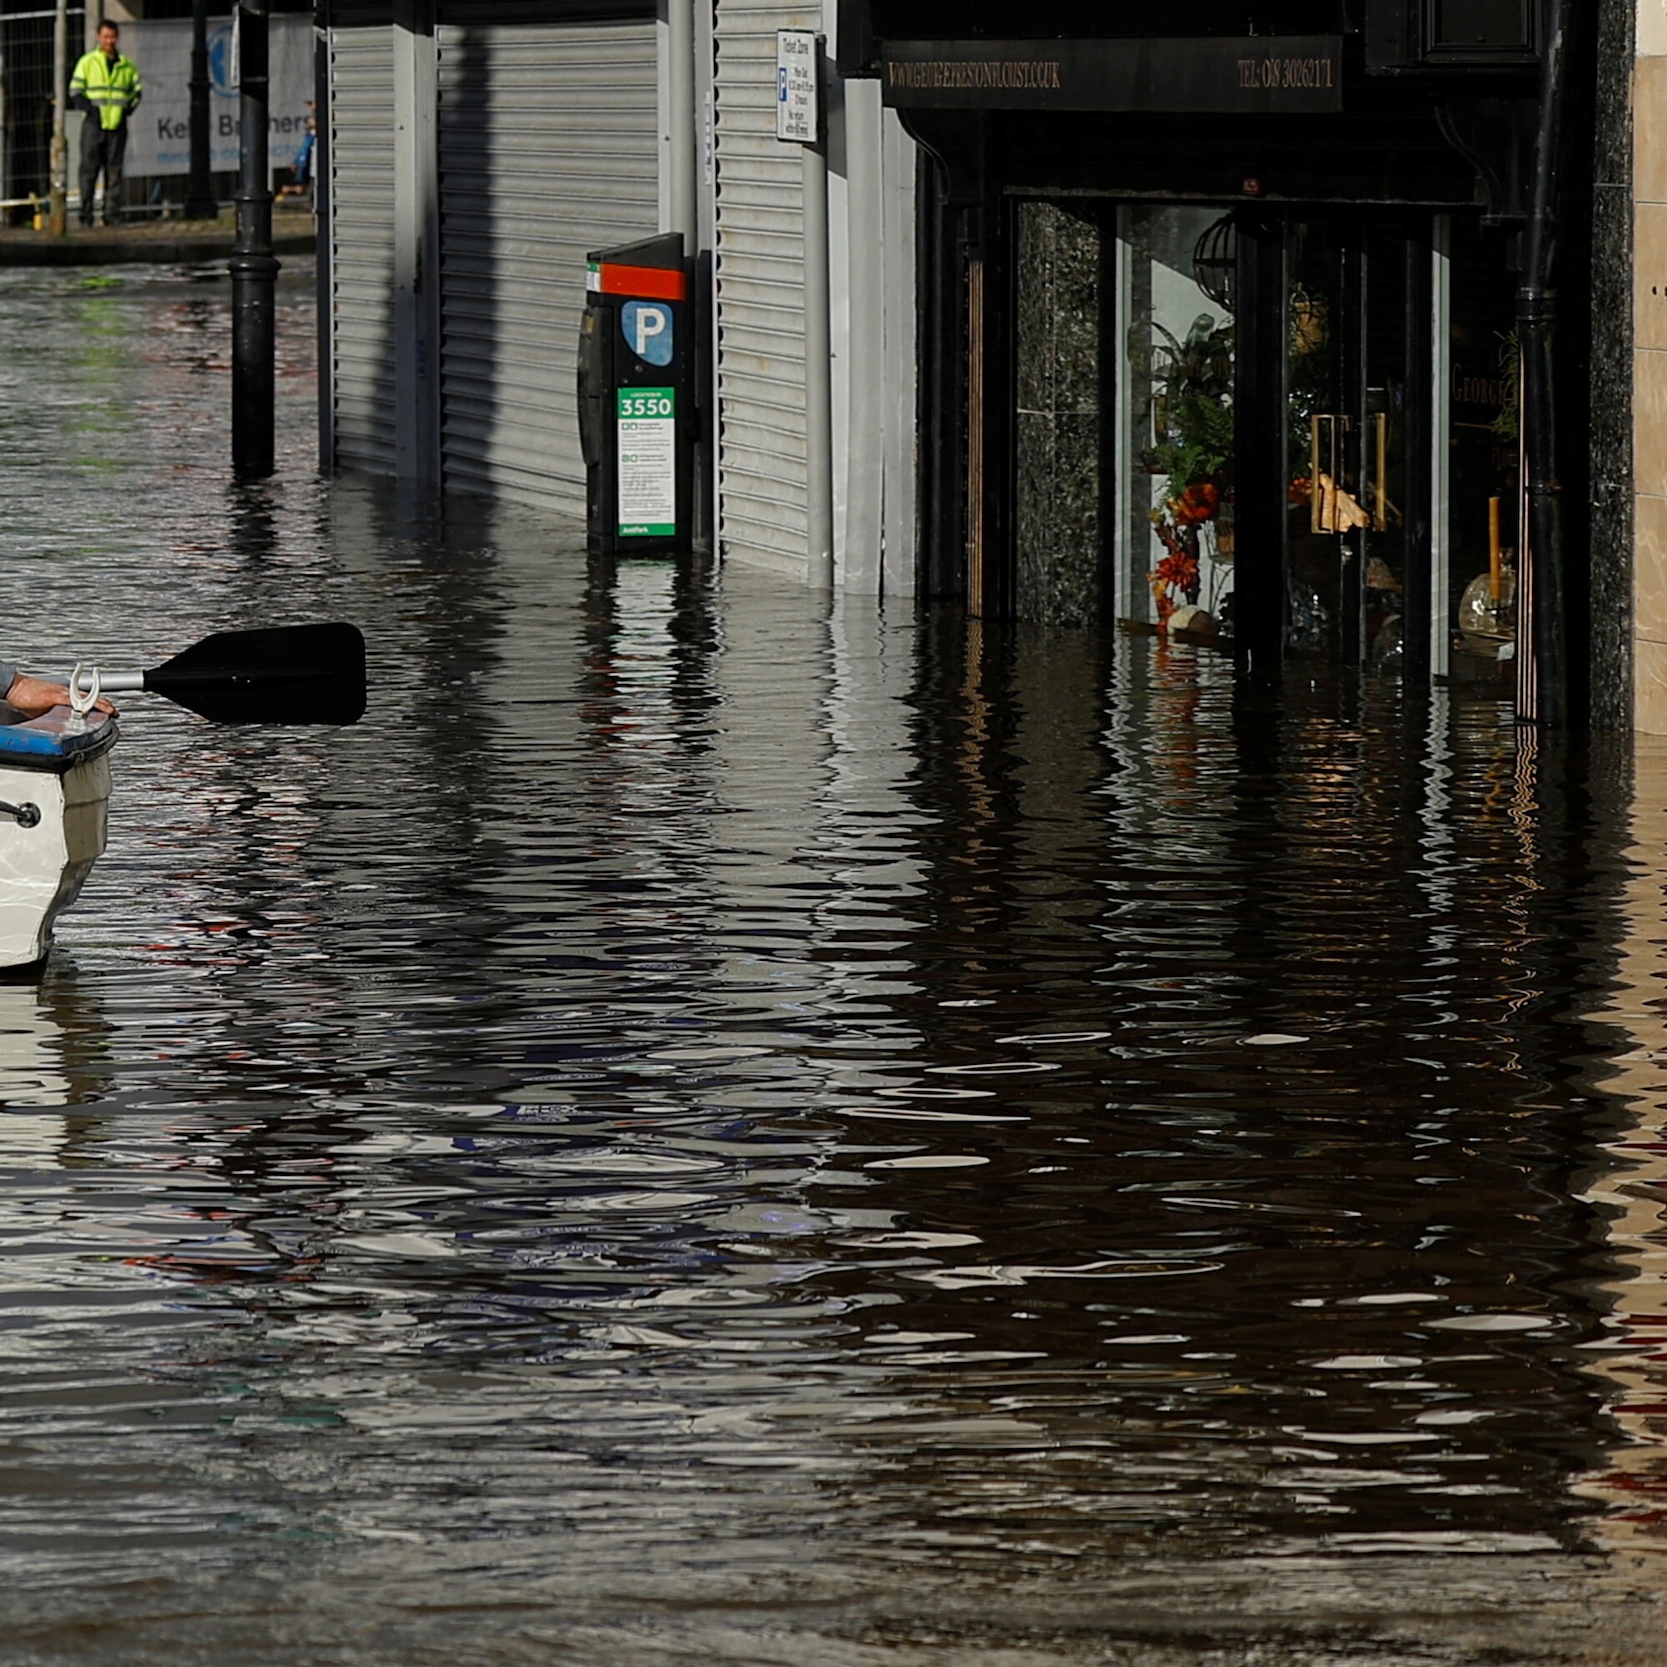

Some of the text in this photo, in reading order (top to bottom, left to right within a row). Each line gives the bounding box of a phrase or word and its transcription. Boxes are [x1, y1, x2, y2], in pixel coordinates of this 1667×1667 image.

[1238, 59, 1260, 88] TEL:
[636, 307, 667, 355] P
[620, 398, 672, 416] 3550
